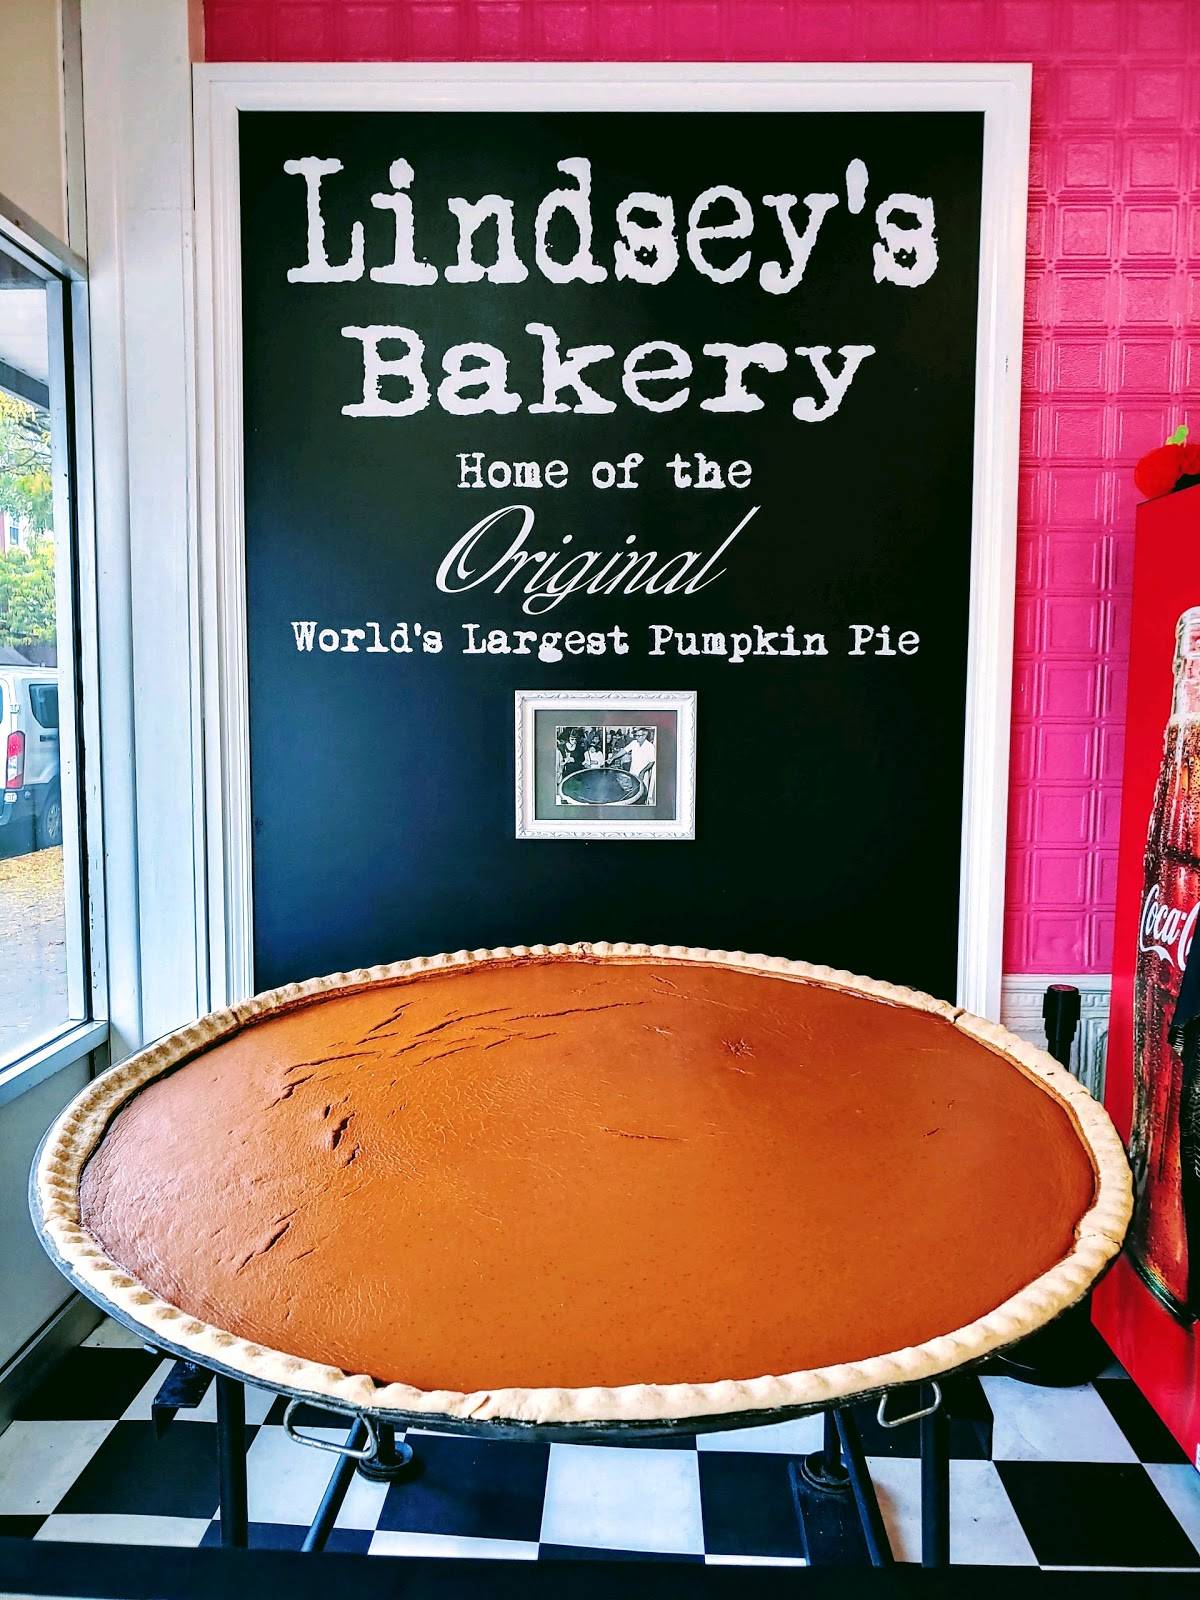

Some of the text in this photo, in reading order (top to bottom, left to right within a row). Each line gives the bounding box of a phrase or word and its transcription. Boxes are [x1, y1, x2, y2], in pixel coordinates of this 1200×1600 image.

[284, 156, 939, 294] Lindsey's
[341, 323, 876, 422] Bakery
[456, 453, 752, 489] Home of the
[436, 505, 761, 615] Original
[291, 622, 919, 663] World's Largest Pumpkin Pie
